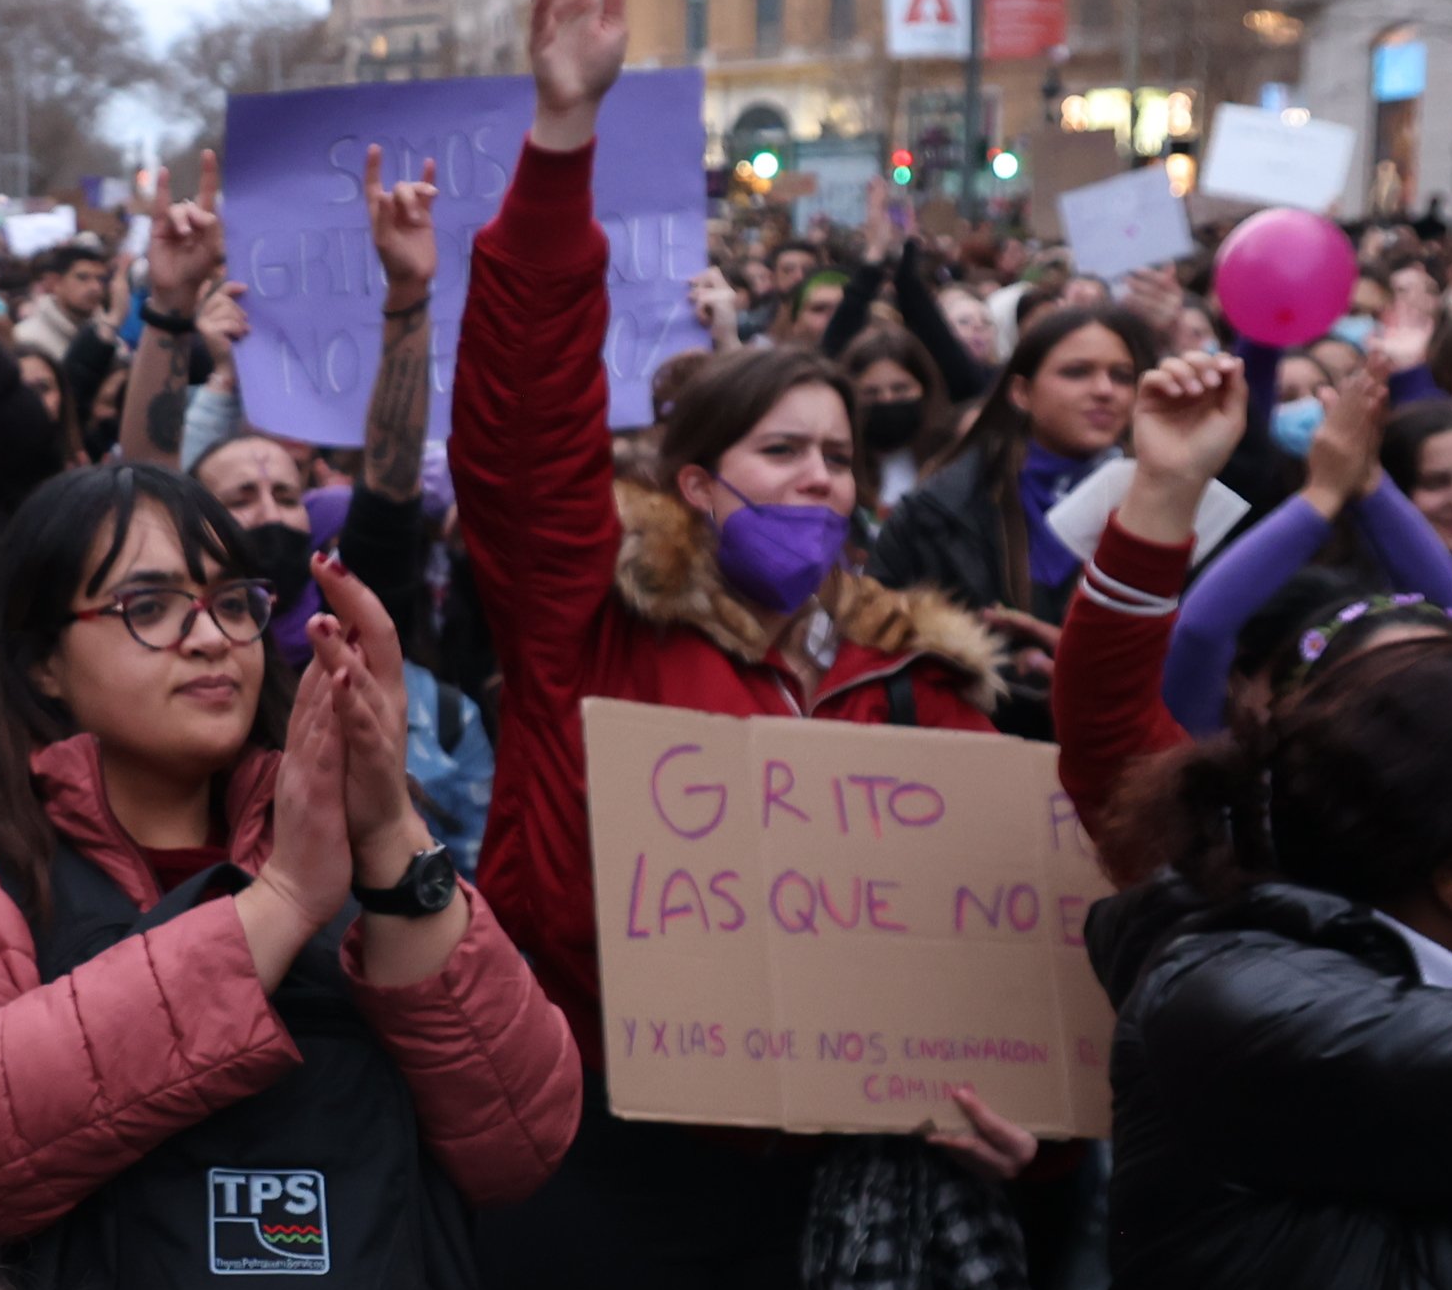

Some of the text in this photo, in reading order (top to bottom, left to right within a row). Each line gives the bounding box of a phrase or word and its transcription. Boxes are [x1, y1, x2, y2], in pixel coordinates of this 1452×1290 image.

[249, 225, 386, 299] GRIT
[650, 743, 946, 840] GRITO
[626, 852, 746, 939] LAS
[768, 868, 908, 936] QUE
[954, 881, 1040, 933] NO
[746, 1027, 798, 1060] QUE
[818, 1031, 888, 1066] NOS
[213, 1174, 319, 1216] TPS
